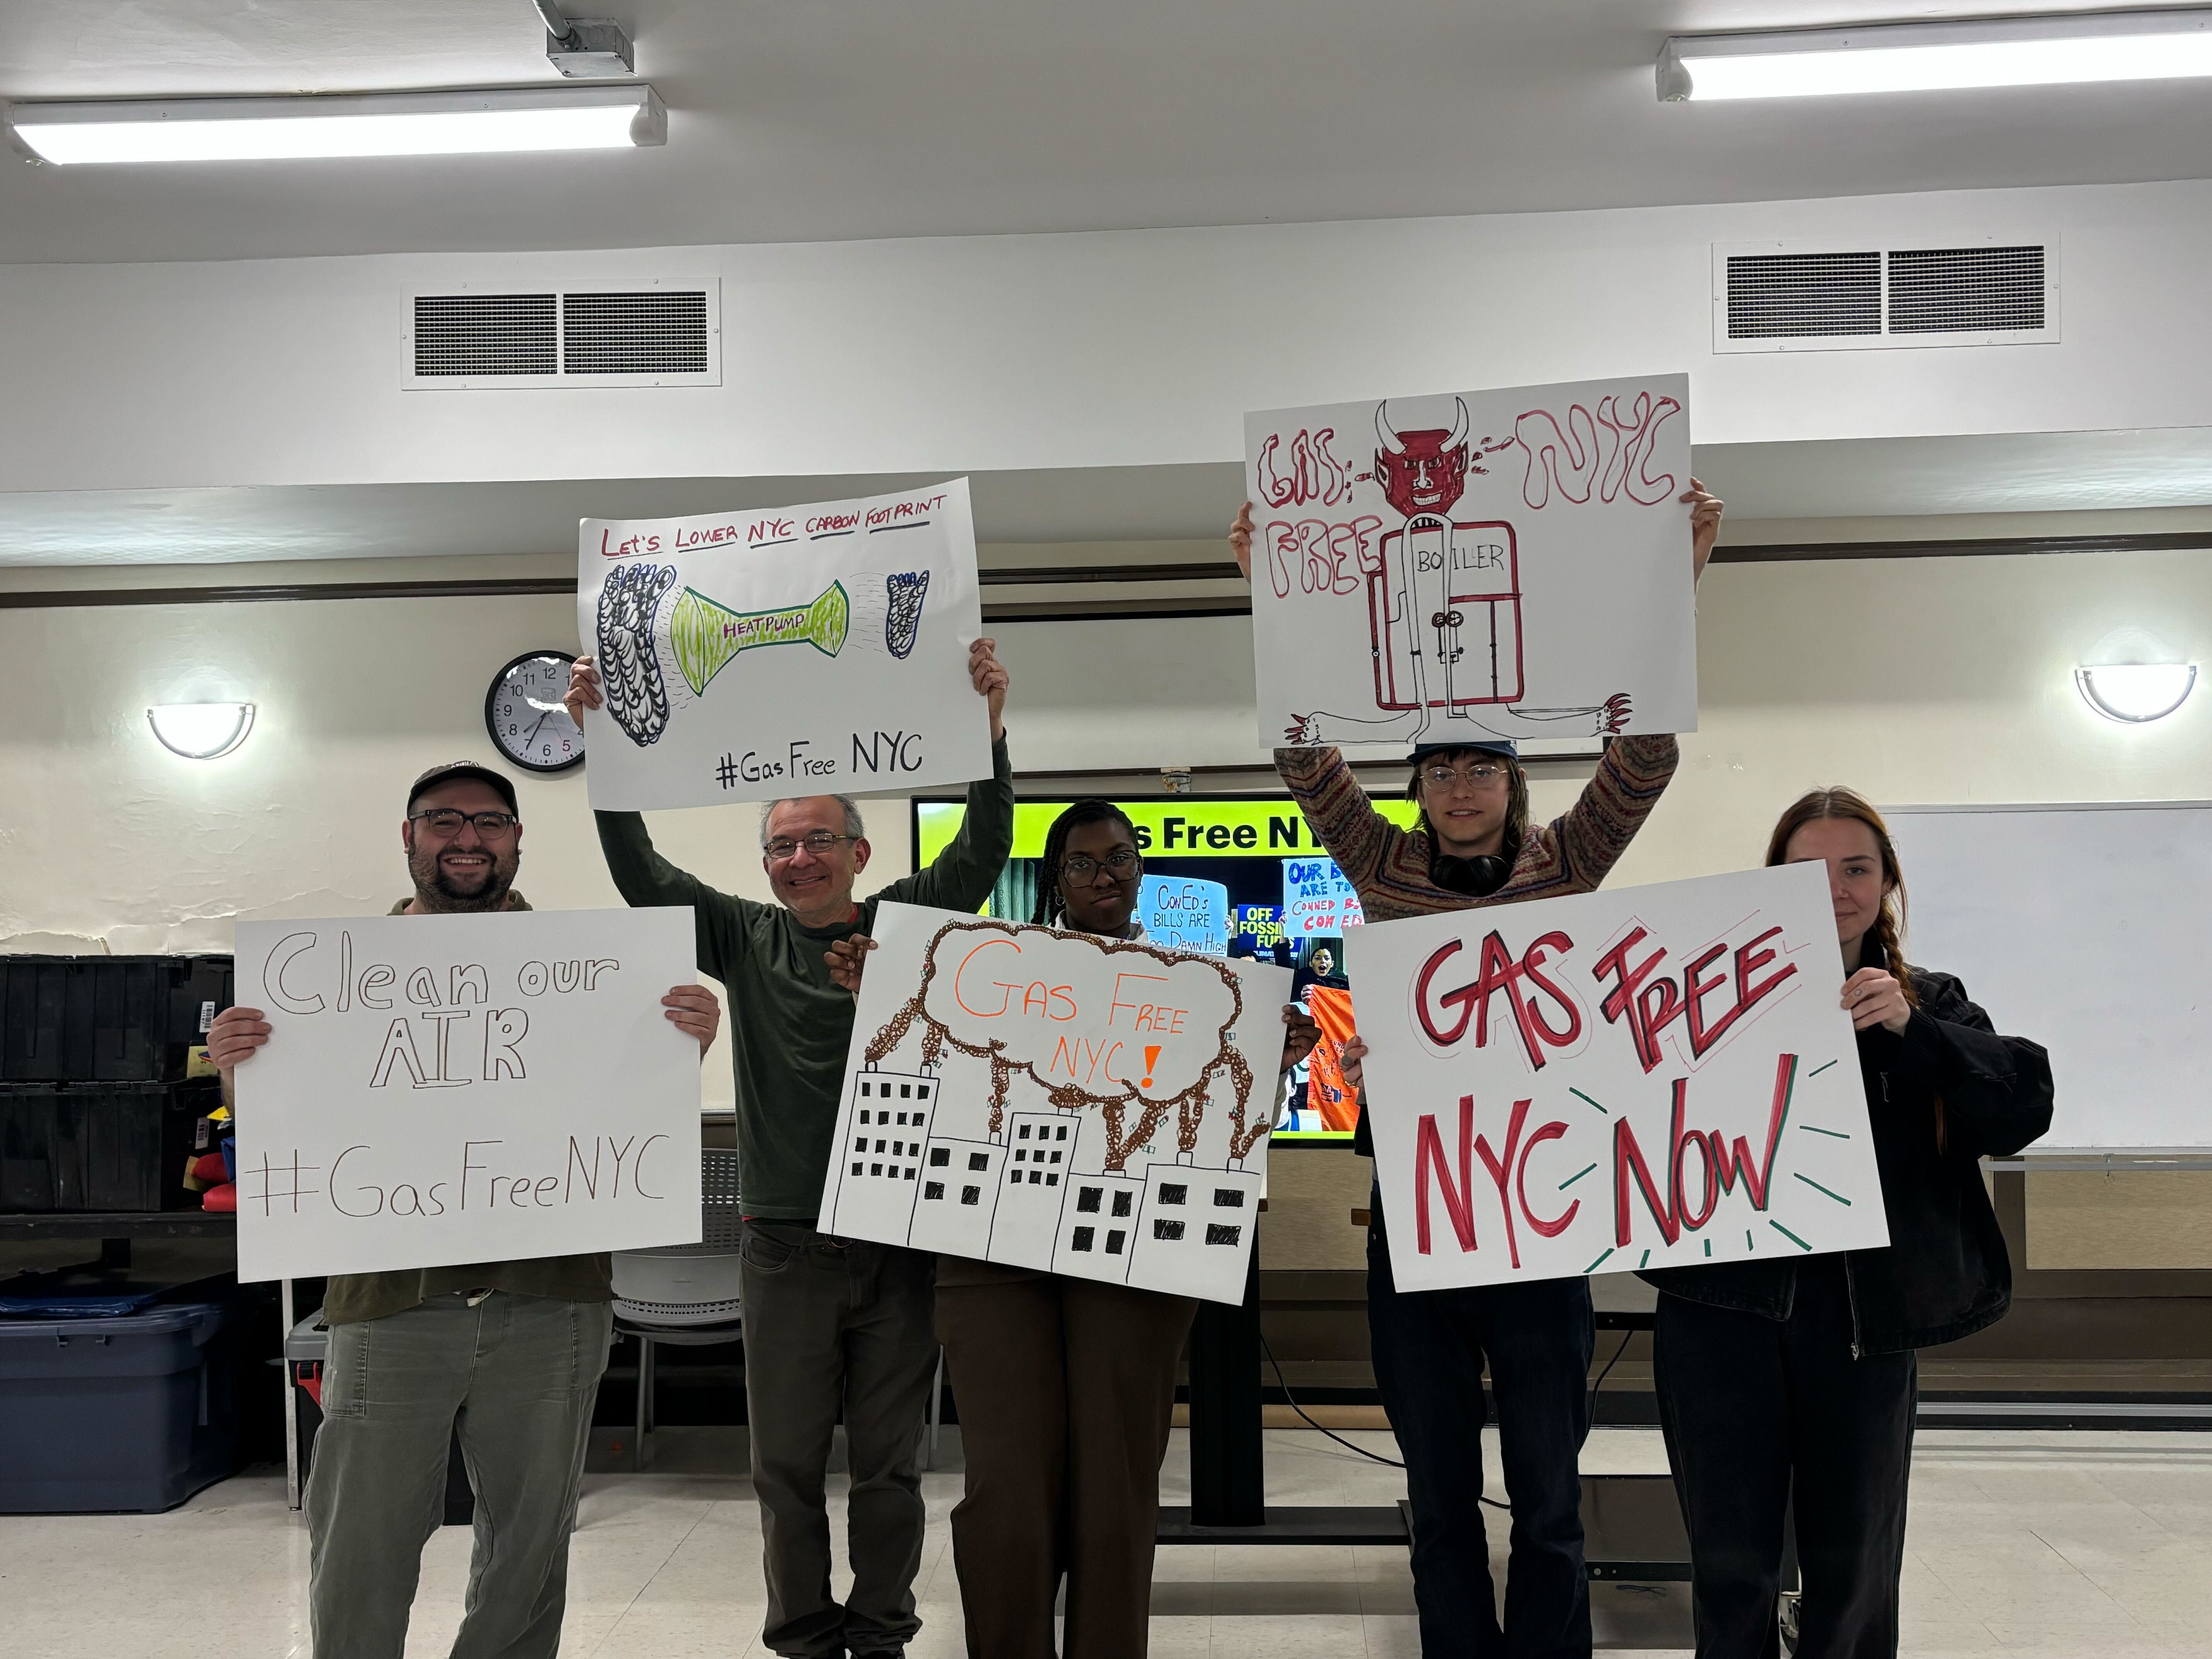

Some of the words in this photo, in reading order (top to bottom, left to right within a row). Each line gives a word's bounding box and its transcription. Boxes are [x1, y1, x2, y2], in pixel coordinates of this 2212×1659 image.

[1515, 391, 1681, 510] NYC
[1258, 428, 1344, 508] GAS
[675, 525, 738, 547] LOWER
[747, 518, 795, 542] NYC
[805, 510, 860, 533] CARBON
[1266, 515, 1383, 598] FREE
[1417, 545, 1504, 572] BOILER
[523, 673, 534, 685] 11
[543, 667, 556, 679] 12
[510, 685, 523, 697] 10
[504, 705, 512, 716] 9
[509, 724, 517, 735] 8
[543, 744, 551, 756] 6
[563, 740, 570, 752] 5
[853, 731, 922, 773] NYC
[1164, 817, 1257, 849] Free
[1288, 862, 1325, 884] OUR
[1300, 881, 1328, 897] ARE
[1335, 881, 1355, 892] TO
[1154, 912, 1183, 927] BILLS
[1188, 914, 1210, 927] ARE
[1247, 907, 1274, 921] OFF
[1292, 900, 1335, 915] CONNED
[1304, 915, 1335, 931] CON
[1340, 914, 1362, 929] ED
[263, 931, 488, 1015] Clean
[518, 958, 620, 996] our
[955, 940, 1077, 1020] GAS
[1109, 972, 1189, 1034] FREE
[1415, 929, 1583, 1072] GAS
[1592, 926, 1798, 1073] FREE
[369, 1008, 529, 1089] AIR
[1415, 1094, 1581, 1269] NYC
[1613, 1053, 1799, 1248] NOW
[244, 1135, 670, 1217] #GasFreeNYC
